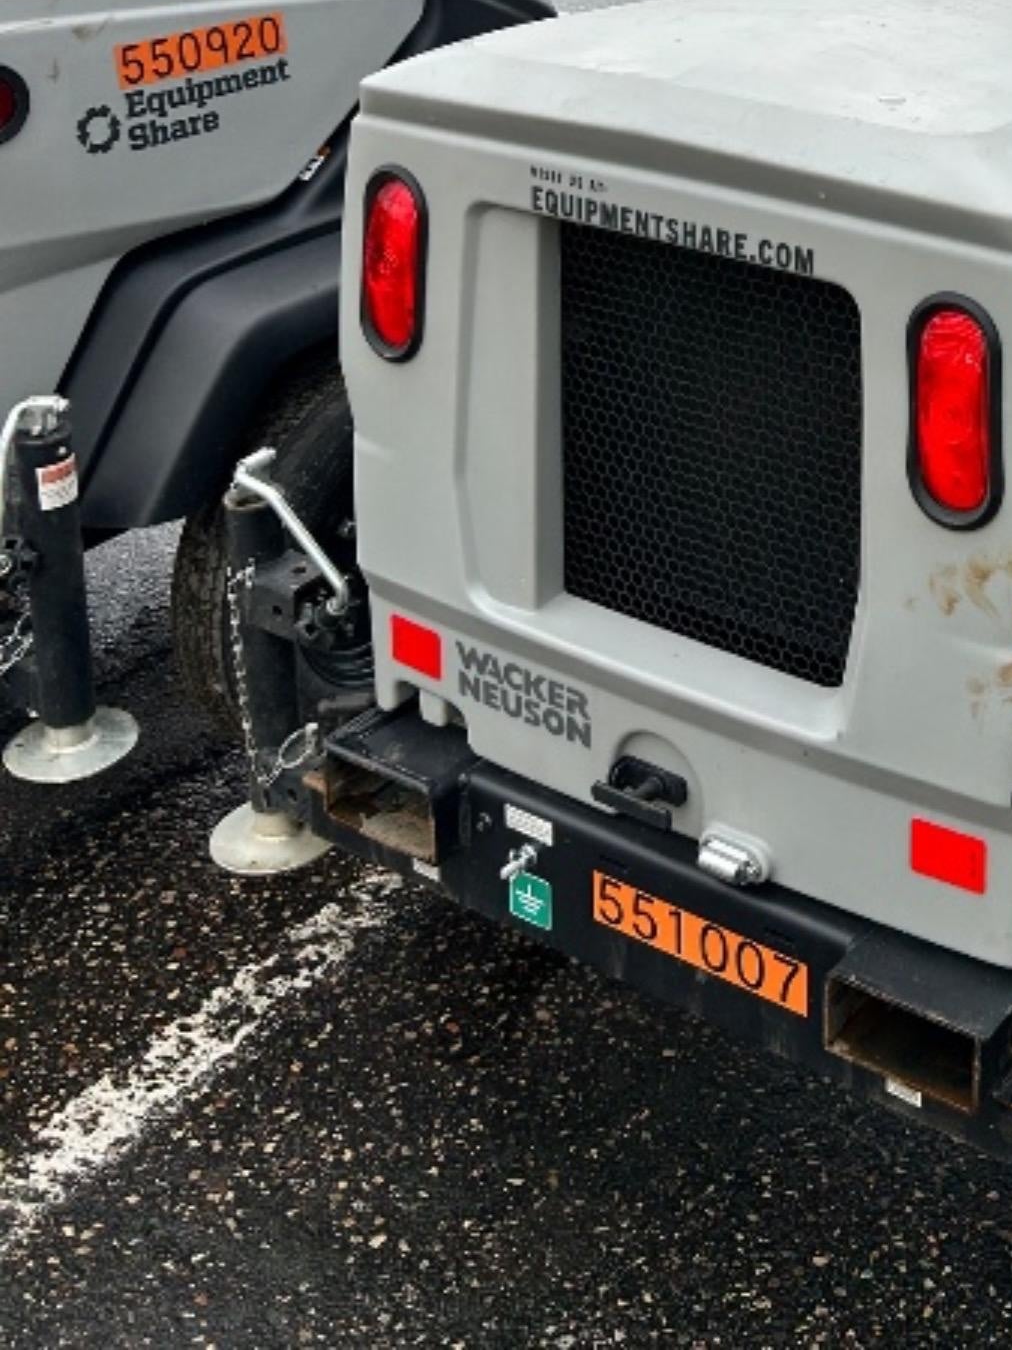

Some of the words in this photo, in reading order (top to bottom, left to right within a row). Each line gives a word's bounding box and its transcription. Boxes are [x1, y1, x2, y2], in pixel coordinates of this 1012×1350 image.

[121, 16, 281, 85] 550920
[124, 57, 291, 120] Equipment
[127, 111, 220, 151] Share
[531, 186, 815, 275] EQUIPMENTSHARE.COM
[455, 640, 591, 721] WACKER
[458, 669, 592, 750] NEUSON
[598, 877, 800, 1003] 551007
